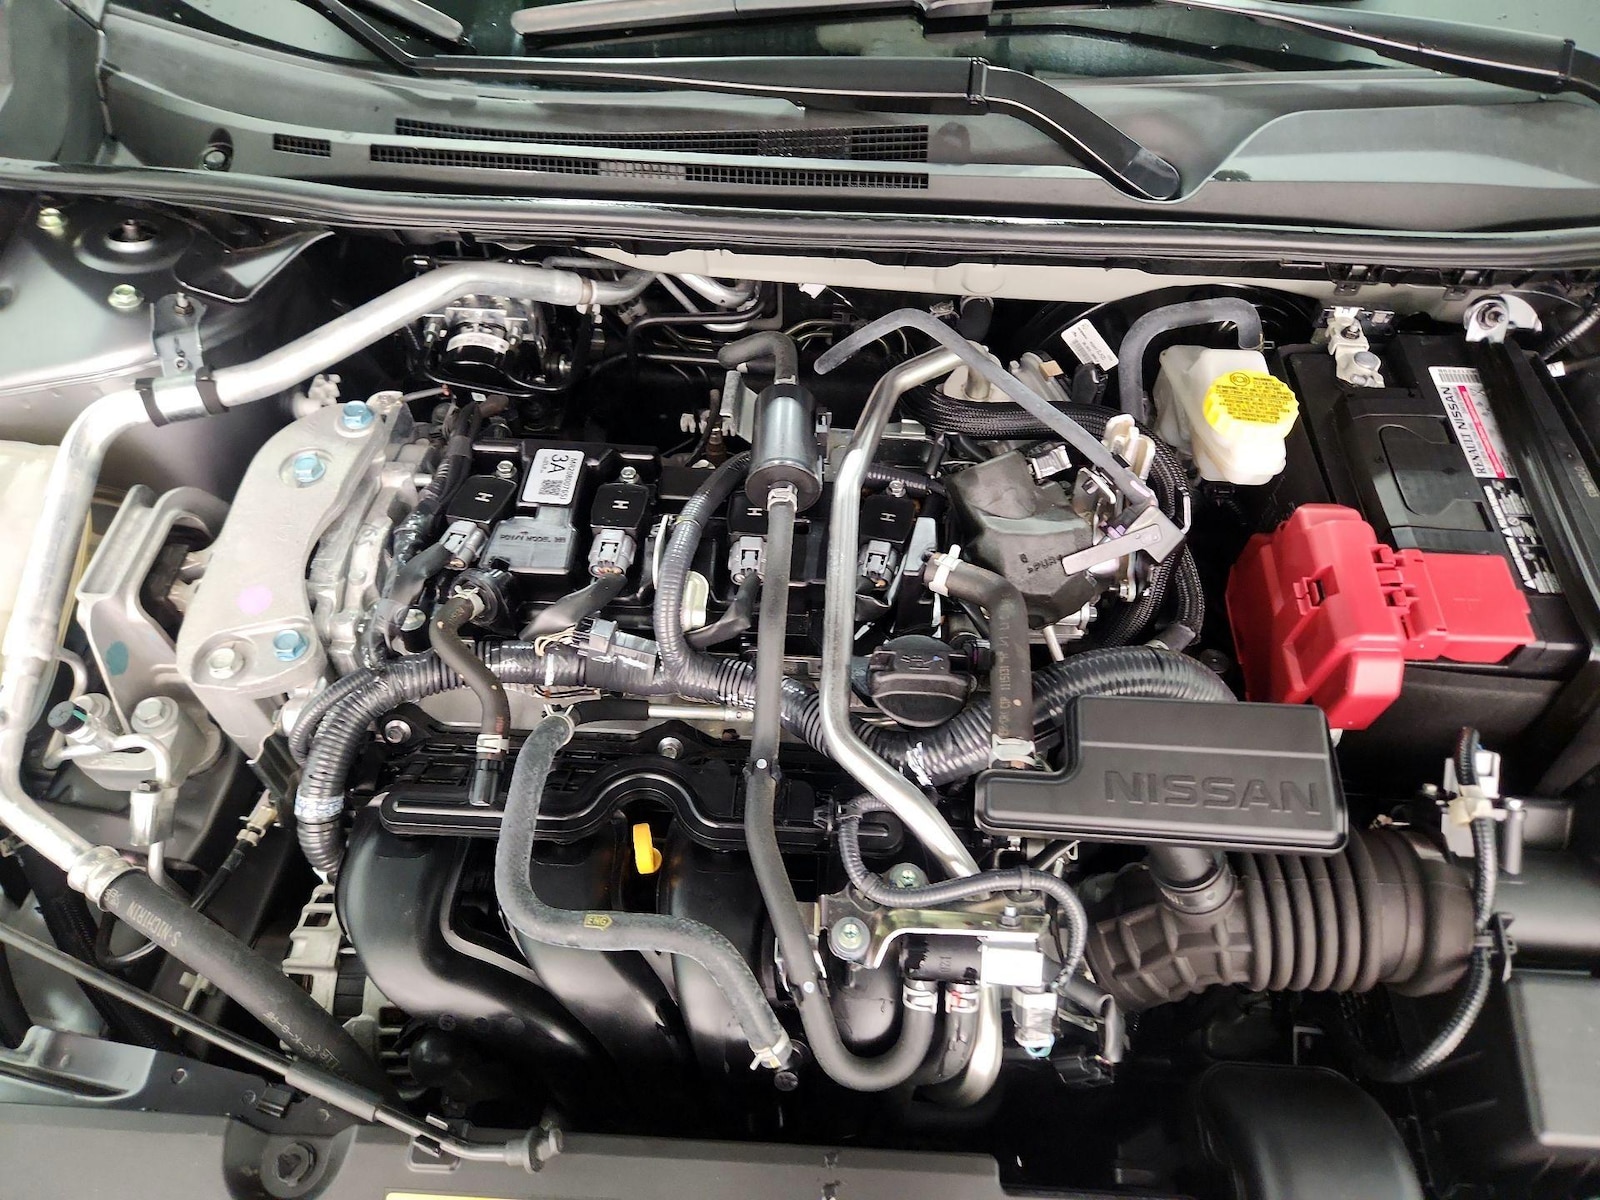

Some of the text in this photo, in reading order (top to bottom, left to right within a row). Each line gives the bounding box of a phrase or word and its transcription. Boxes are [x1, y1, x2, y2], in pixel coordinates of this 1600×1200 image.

[1441, 386, 1468, 430] NISSAN
[547, 454, 569, 474] 3A
[1461, 432, 1487, 474] RENAULT
[1104, 770, 1321, 815] NISSAN
